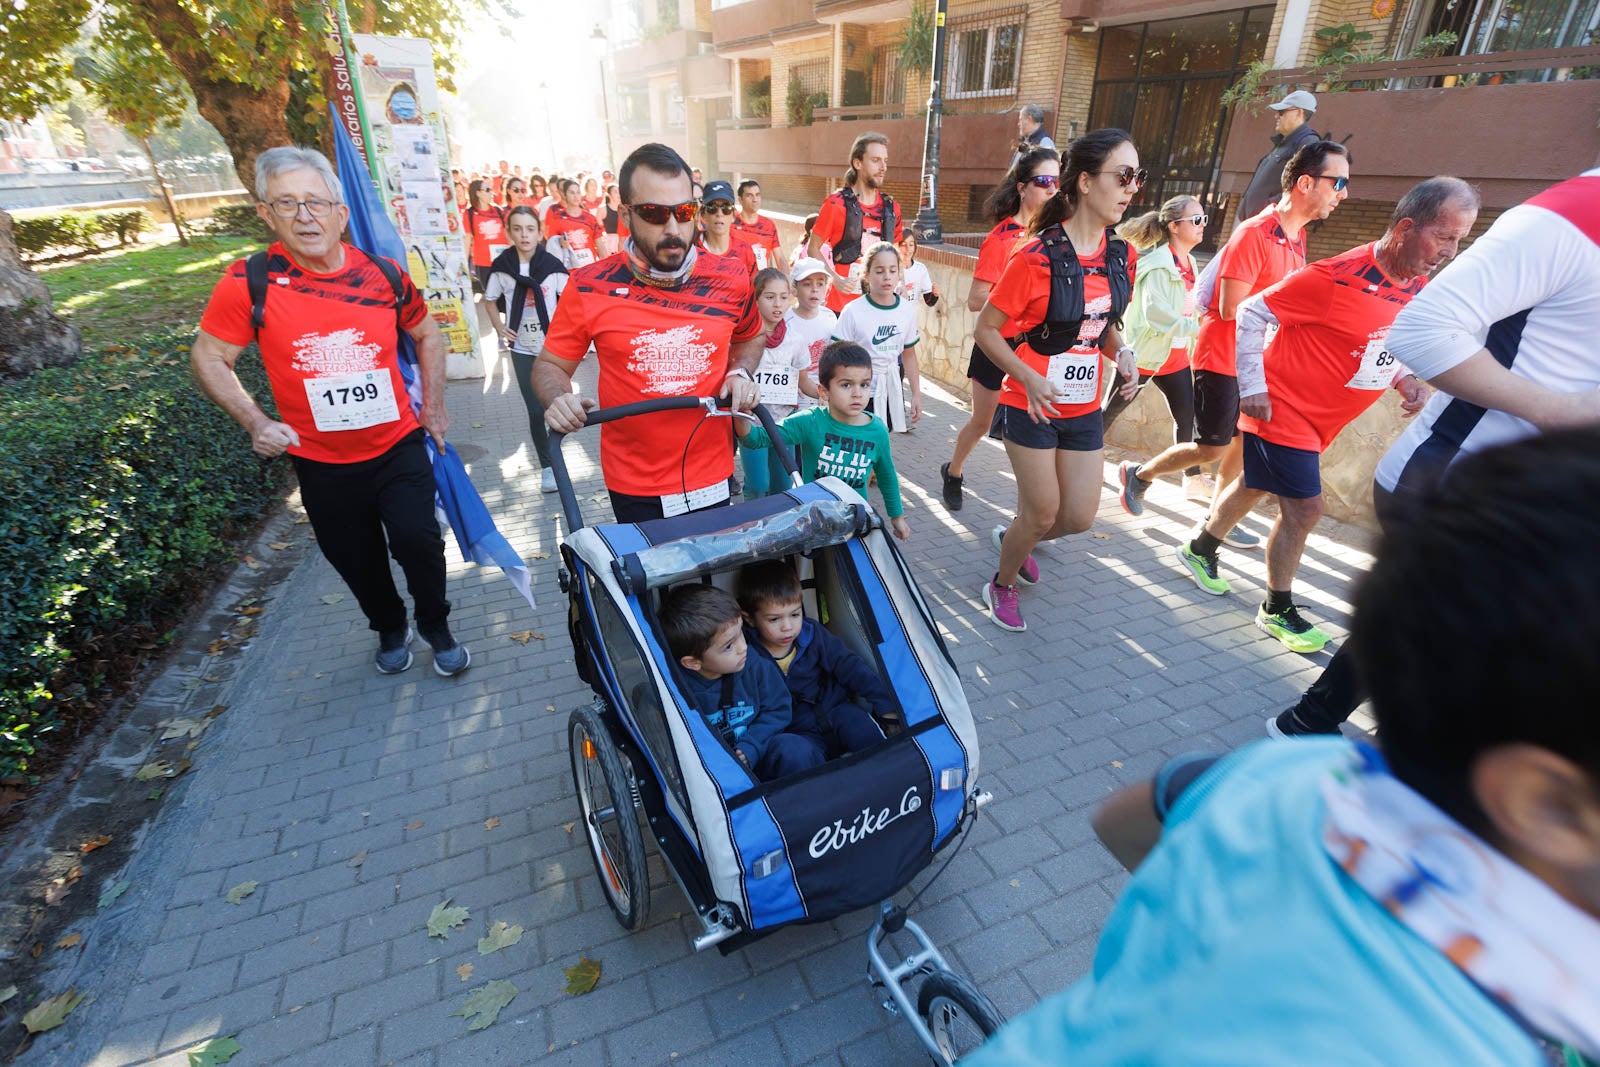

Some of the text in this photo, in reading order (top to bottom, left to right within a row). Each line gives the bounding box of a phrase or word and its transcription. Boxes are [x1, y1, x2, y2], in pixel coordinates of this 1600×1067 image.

[876, 325, 897, 337] NIKE
[636, 360, 707, 372] cruzroja.es
[1064, 365, 1095, 381] 806
[755, 372, 789, 386] 1768
[322, 383, 378, 406] 1799
[819, 432, 875, 468] EPIC
